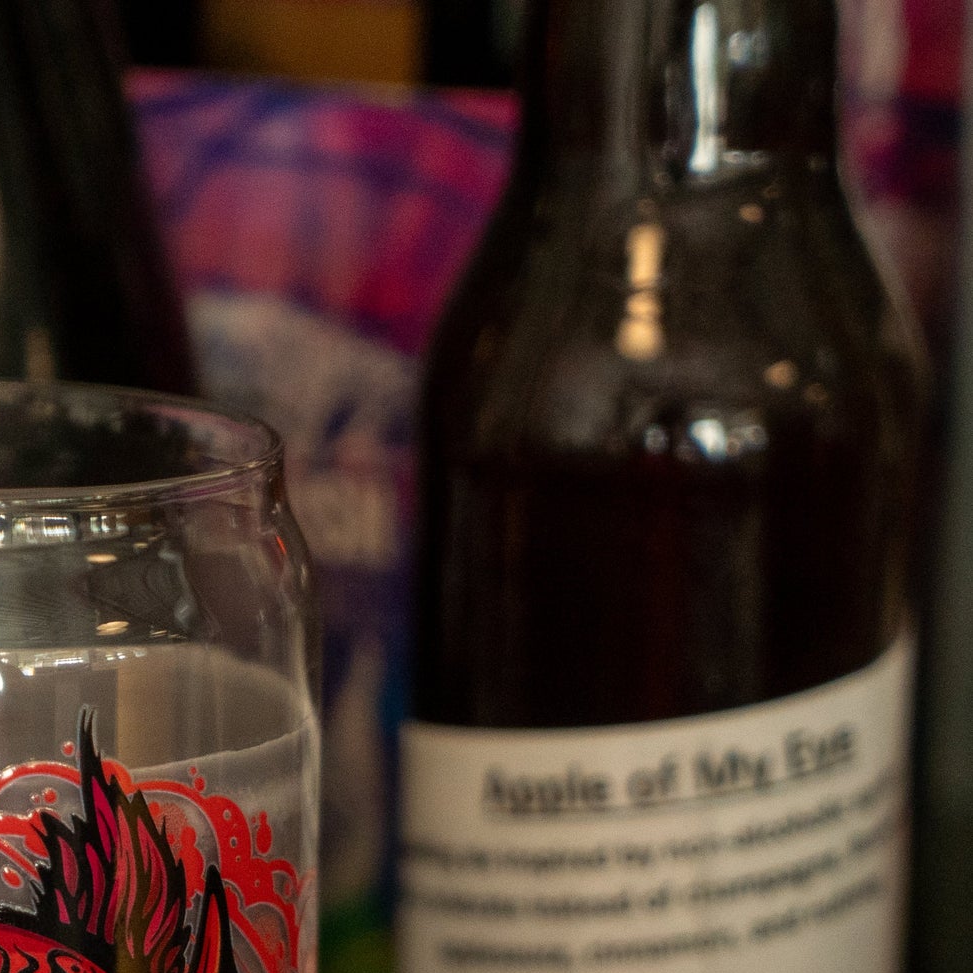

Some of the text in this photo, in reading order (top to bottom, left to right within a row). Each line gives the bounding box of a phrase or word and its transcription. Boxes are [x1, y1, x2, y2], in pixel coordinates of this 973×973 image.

[484, 724, 856, 816] Apple of My Eye
